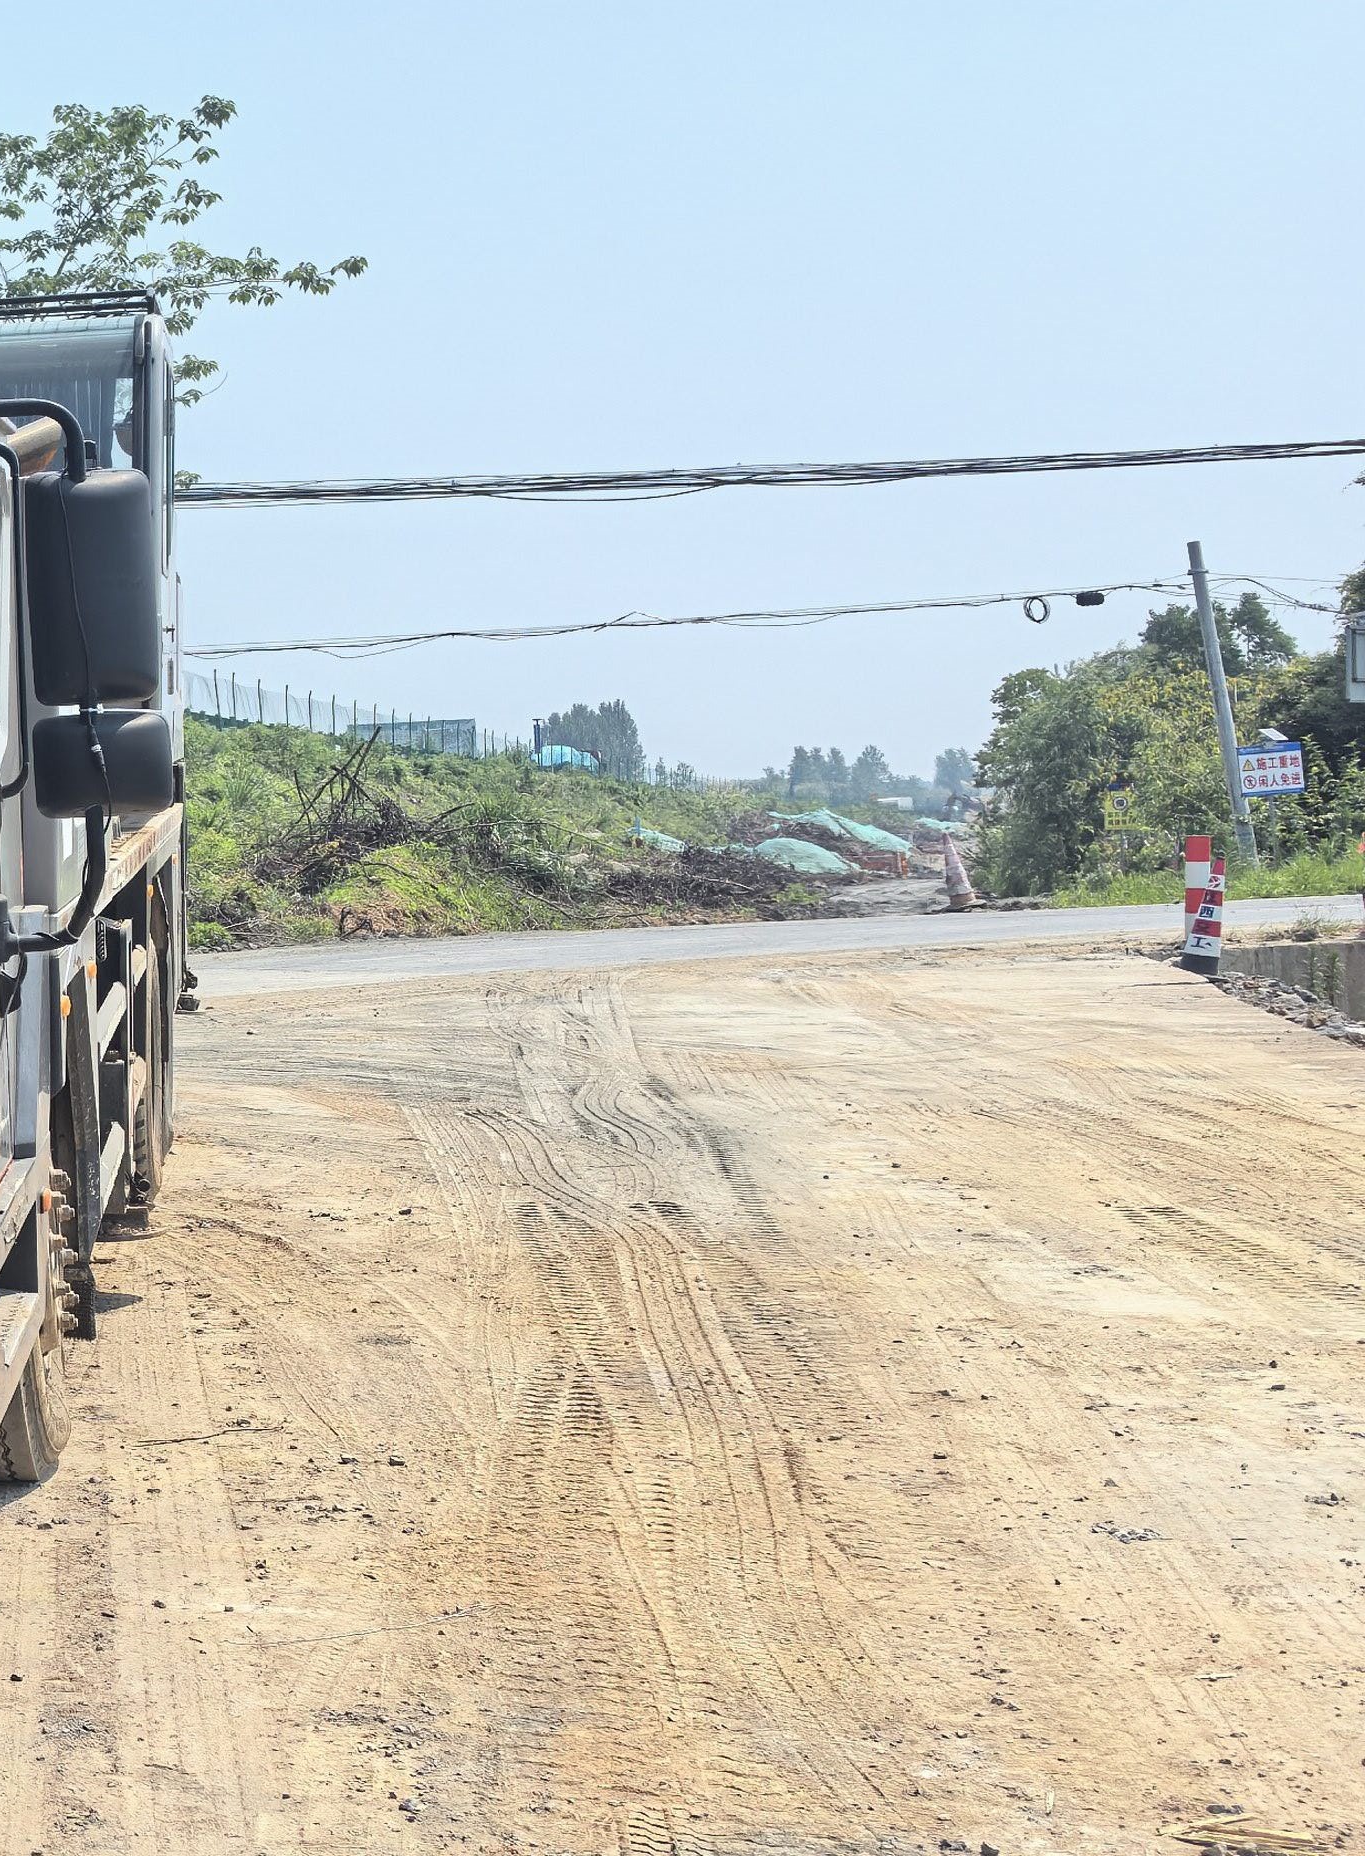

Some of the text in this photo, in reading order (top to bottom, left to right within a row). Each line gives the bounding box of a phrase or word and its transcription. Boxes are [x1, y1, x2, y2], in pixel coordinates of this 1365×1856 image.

[1256, 754, 1300, 770] 施工重地
[1258, 772, 1301, 787] 闲人免进
